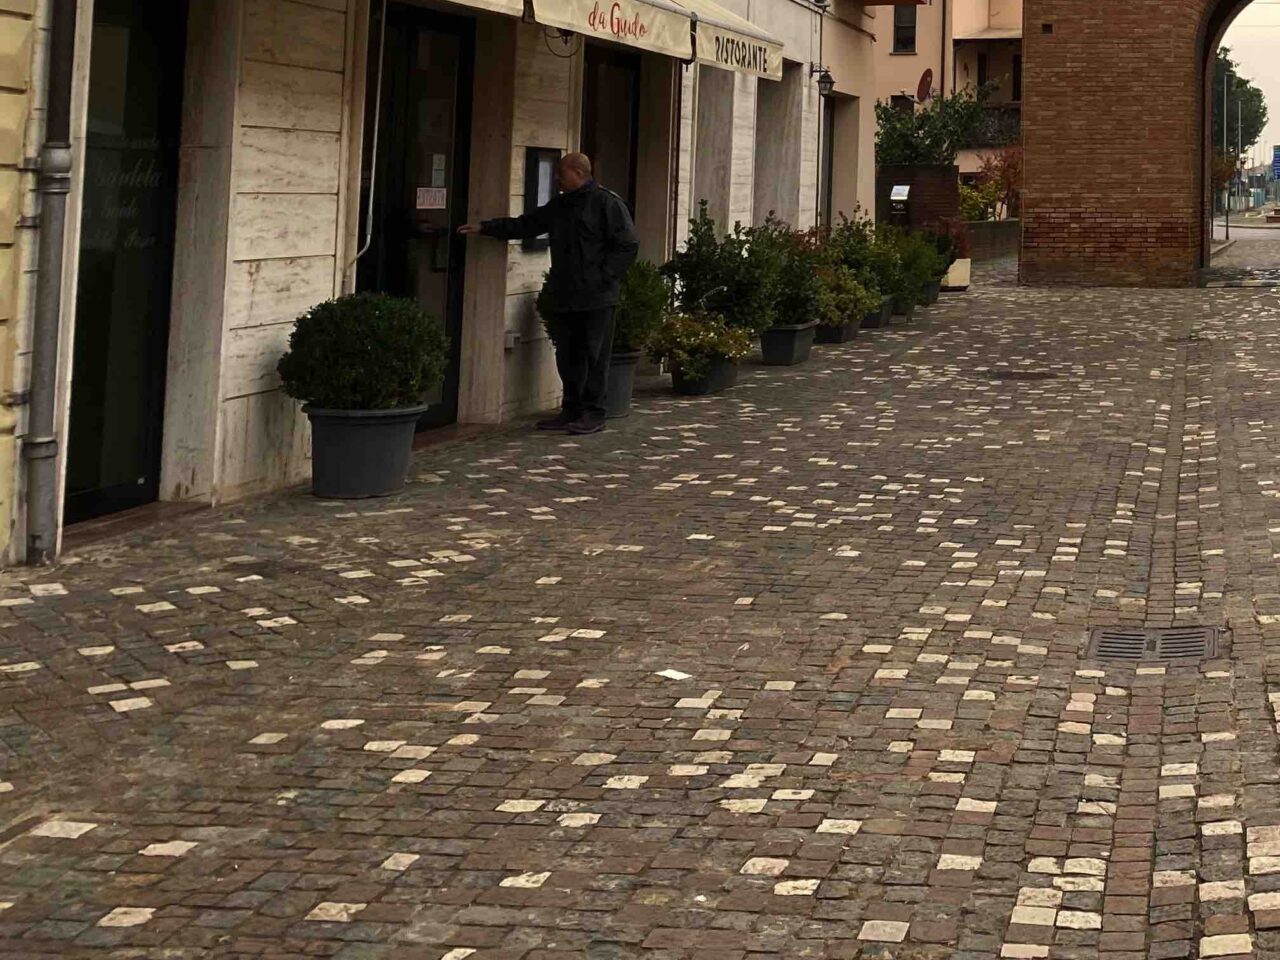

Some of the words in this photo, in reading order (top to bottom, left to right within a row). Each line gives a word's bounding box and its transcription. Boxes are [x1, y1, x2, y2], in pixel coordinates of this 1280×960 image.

[588, 1, 607, 32] da
[609, 2, 648, 40] Guido
[714, 36, 768, 73] RISTORANTE
